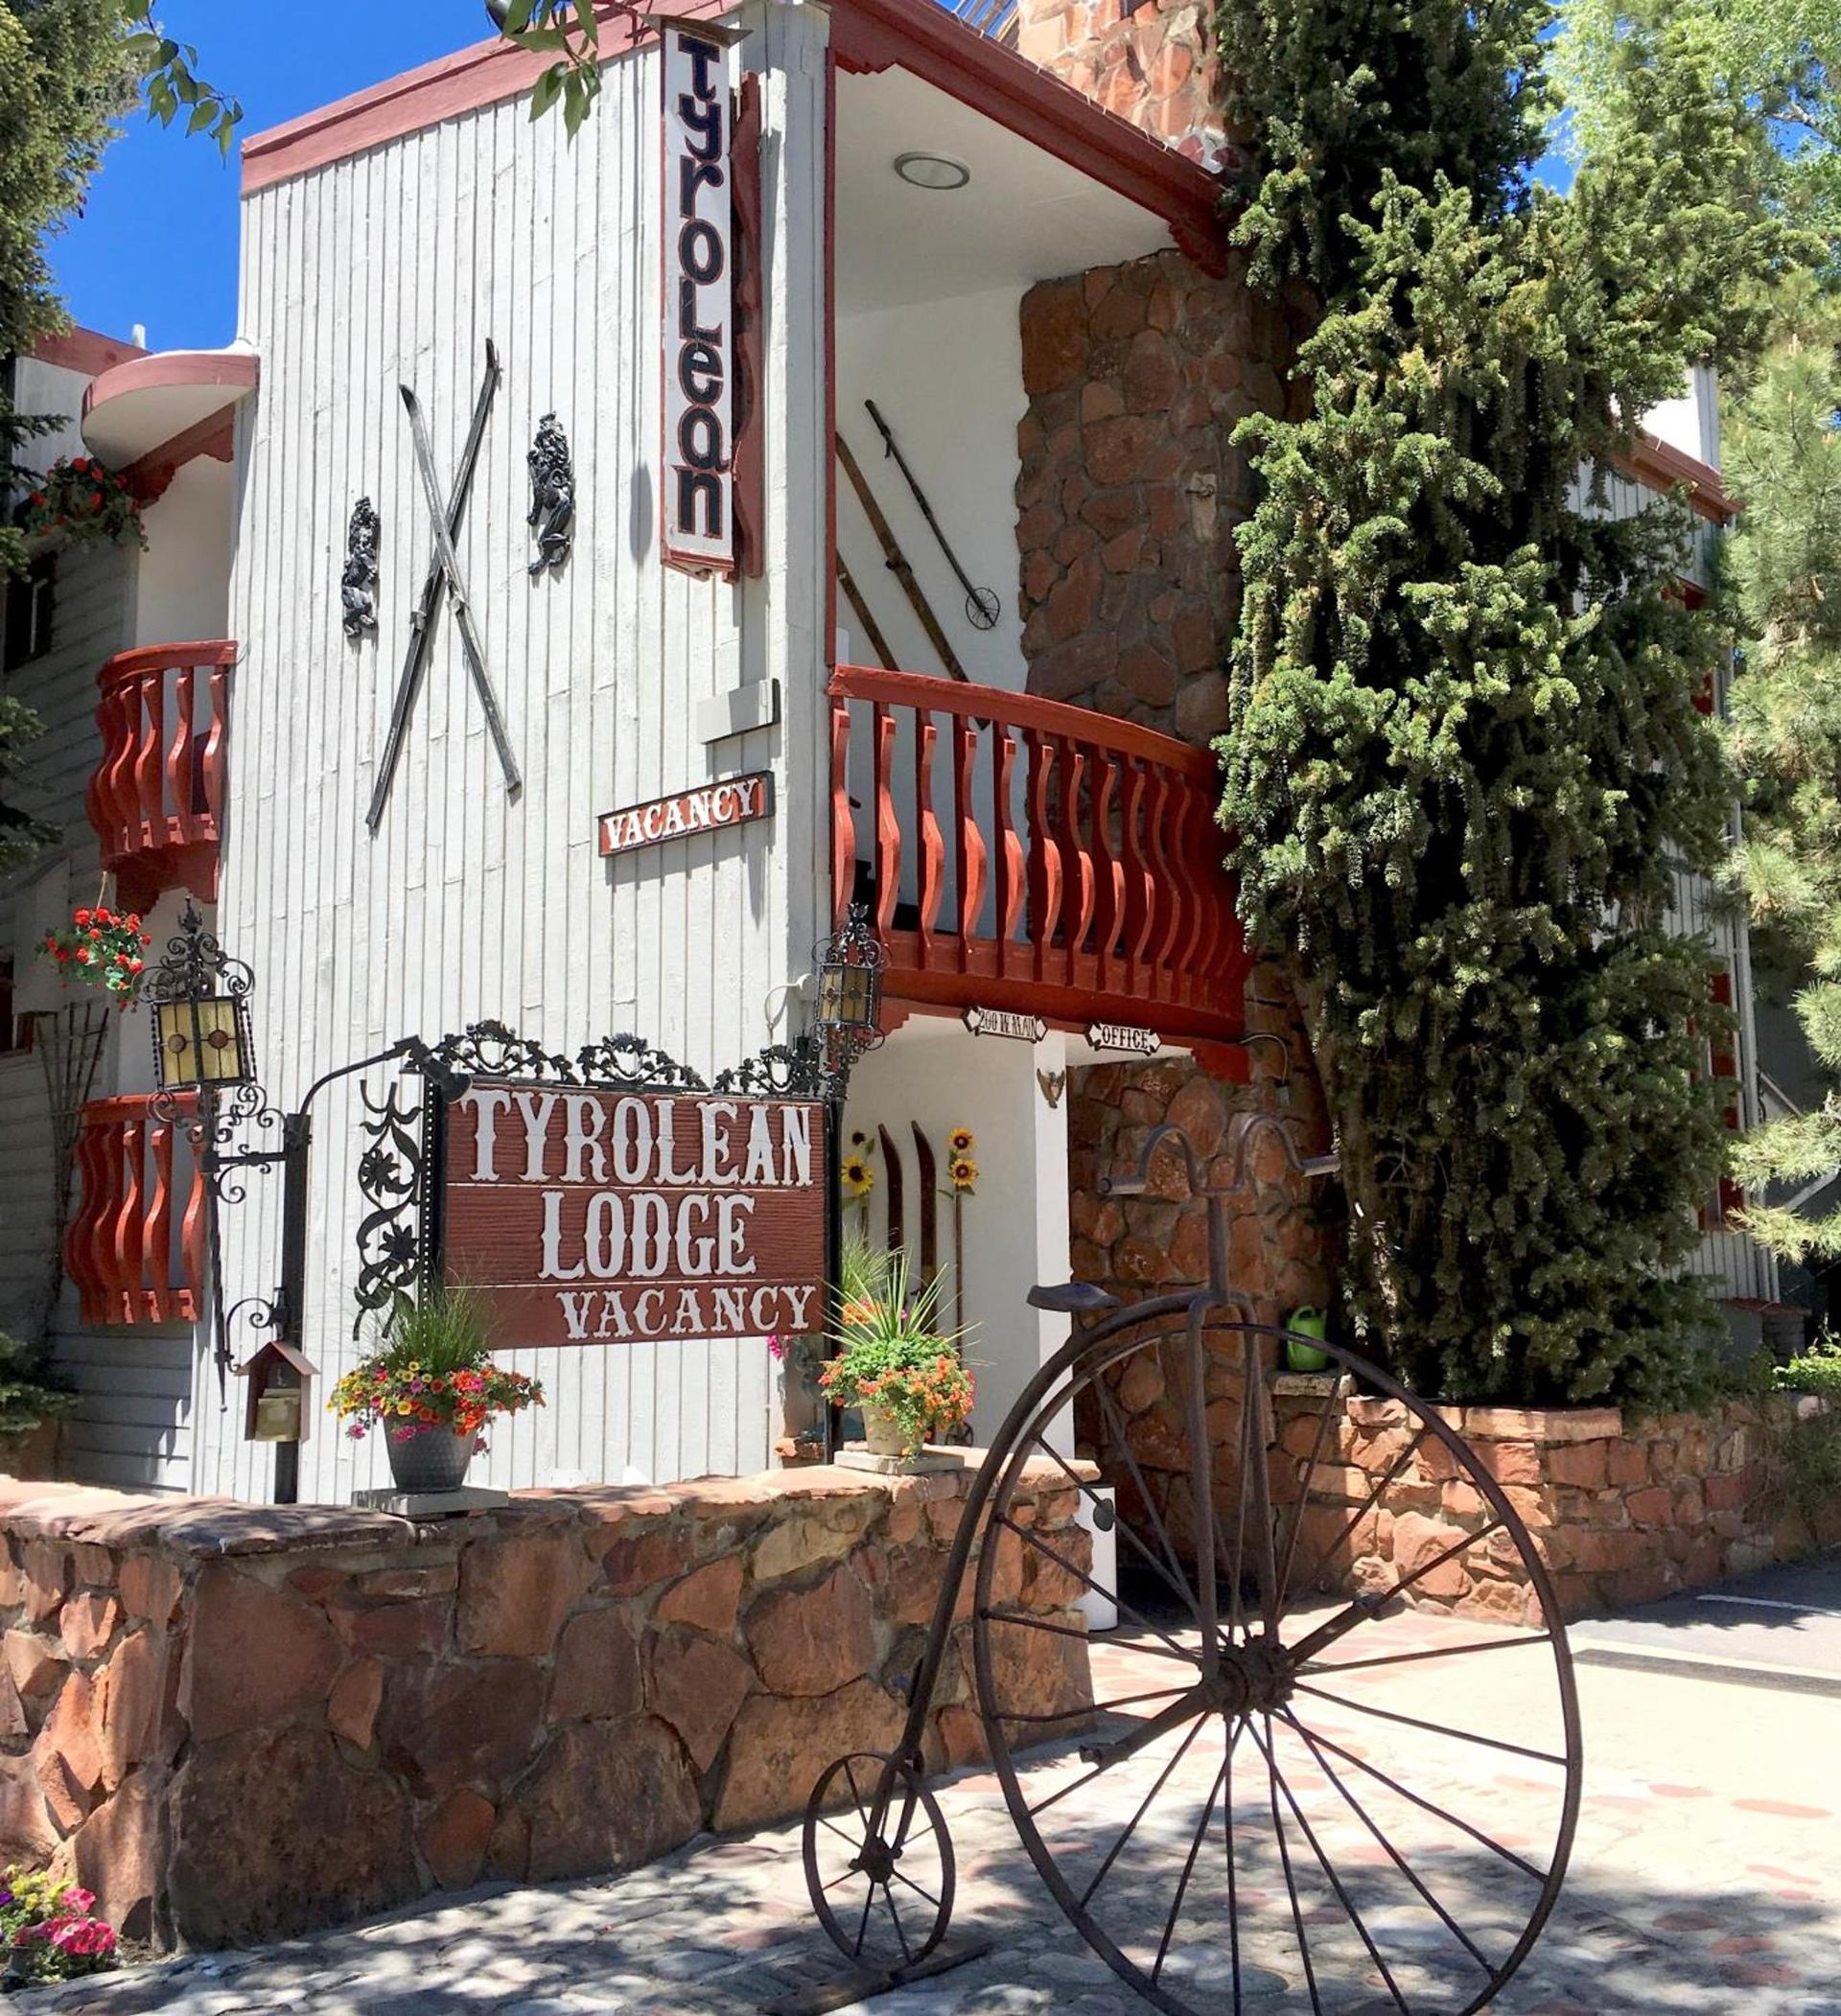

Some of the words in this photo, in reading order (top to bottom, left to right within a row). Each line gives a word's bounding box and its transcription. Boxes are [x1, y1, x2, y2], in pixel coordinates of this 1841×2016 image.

[604, 778, 759, 851] VACANCY
[979, 1010, 997, 1031] 200
[1012, 1014, 1038, 1038] MAIN
[1102, 1025, 1149, 1050] OFFICE
[460, 1090, 814, 1187] TYROLEAN
[538, 1190, 757, 1280] LODGE
[555, 1286, 817, 1339] VACANCY
